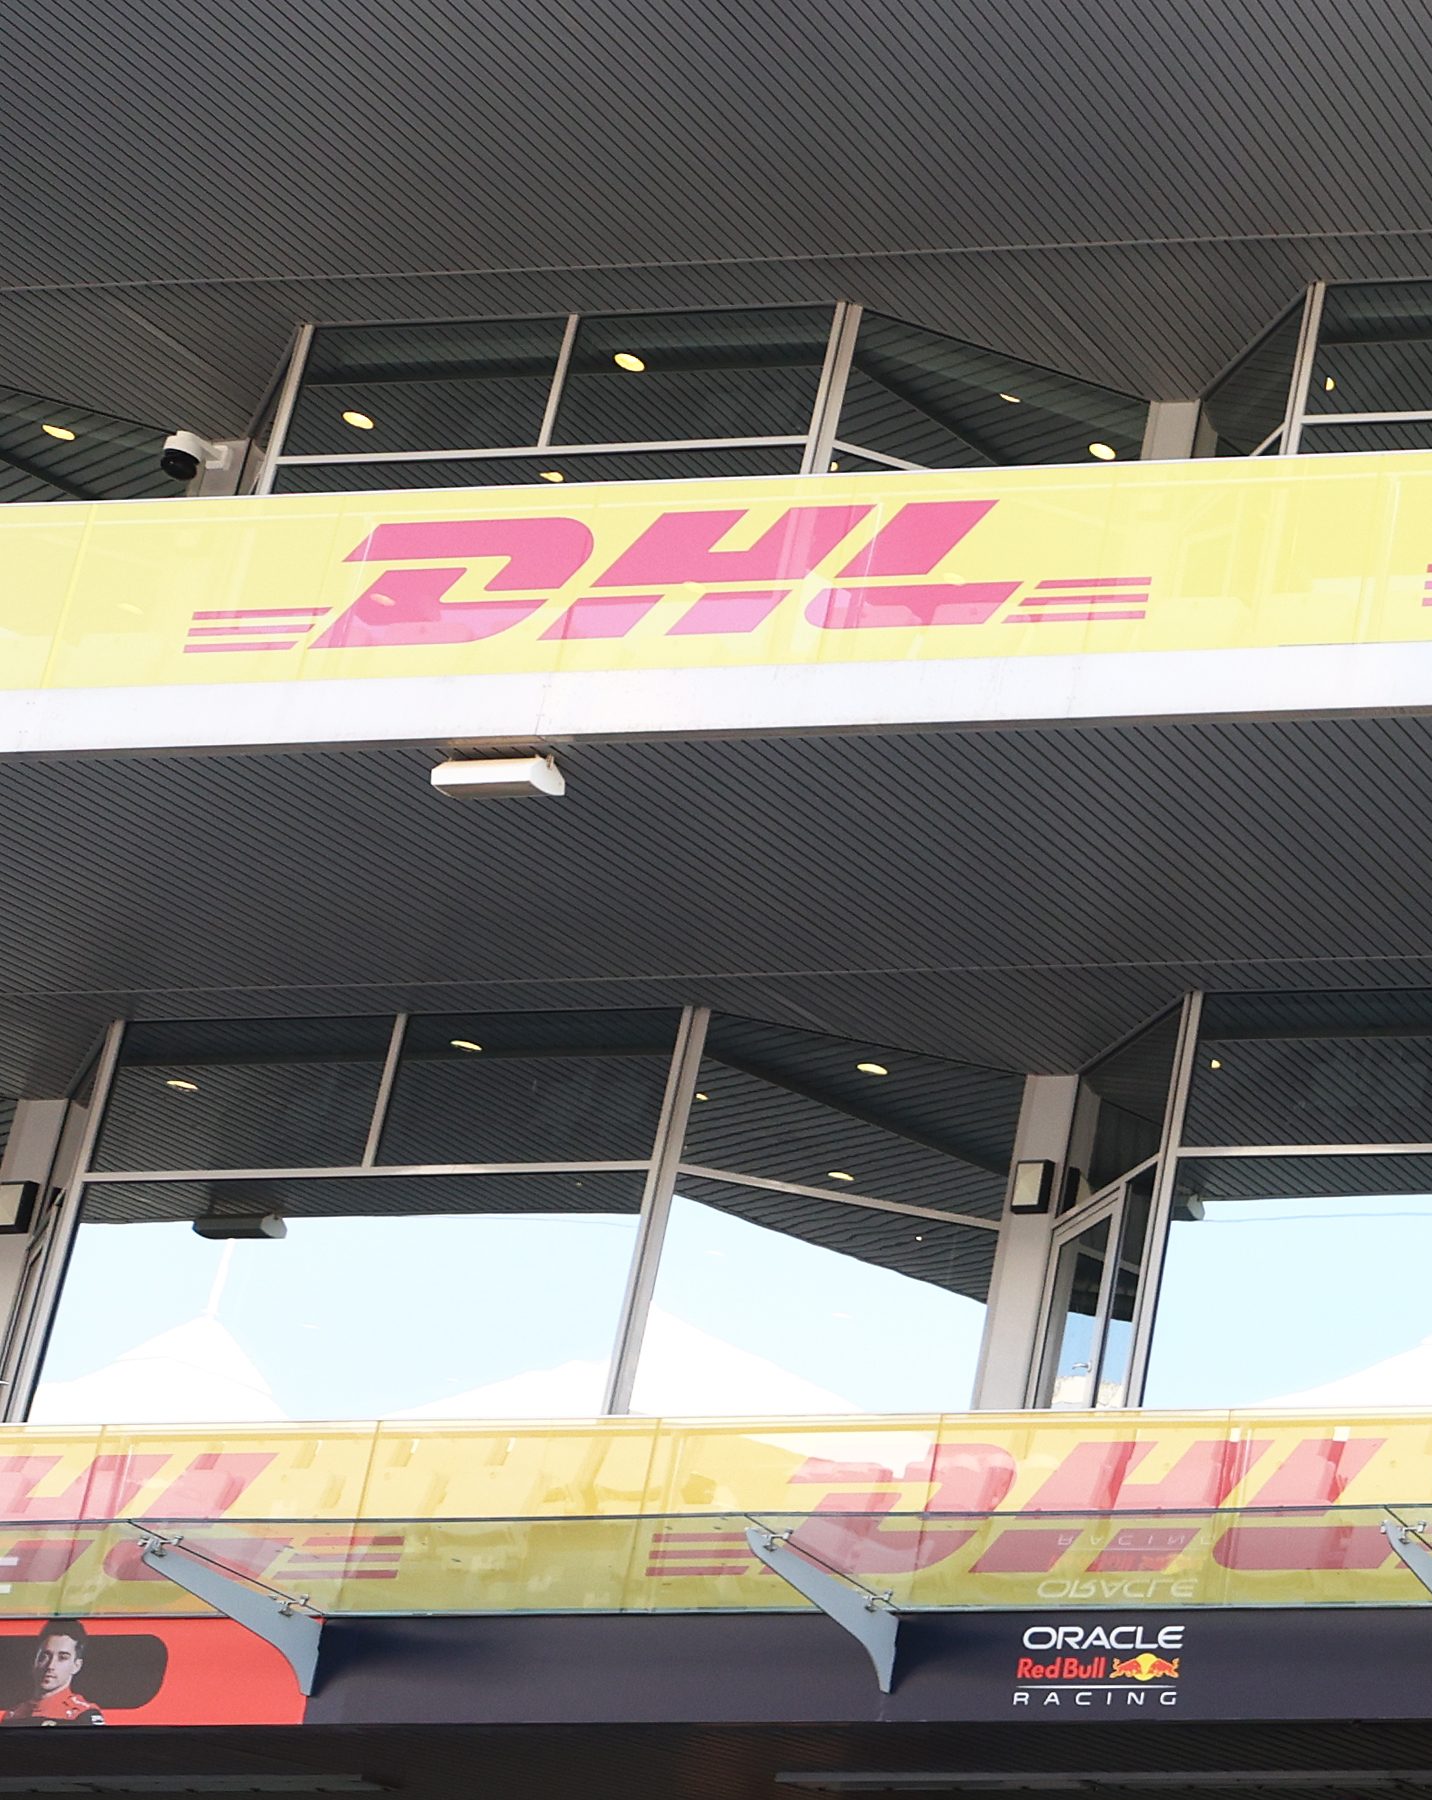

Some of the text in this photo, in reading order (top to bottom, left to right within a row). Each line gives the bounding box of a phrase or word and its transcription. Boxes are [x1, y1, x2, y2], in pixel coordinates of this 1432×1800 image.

[308, 500, 1020, 649] DHL
[762, 1436, 1410, 1575] DHL
[1022, 1625, 1186, 1650] ORACLE
[1016, 1657, 1106, 1679] Red Bull
[1013, 1691, 1177, 1706] RACING
